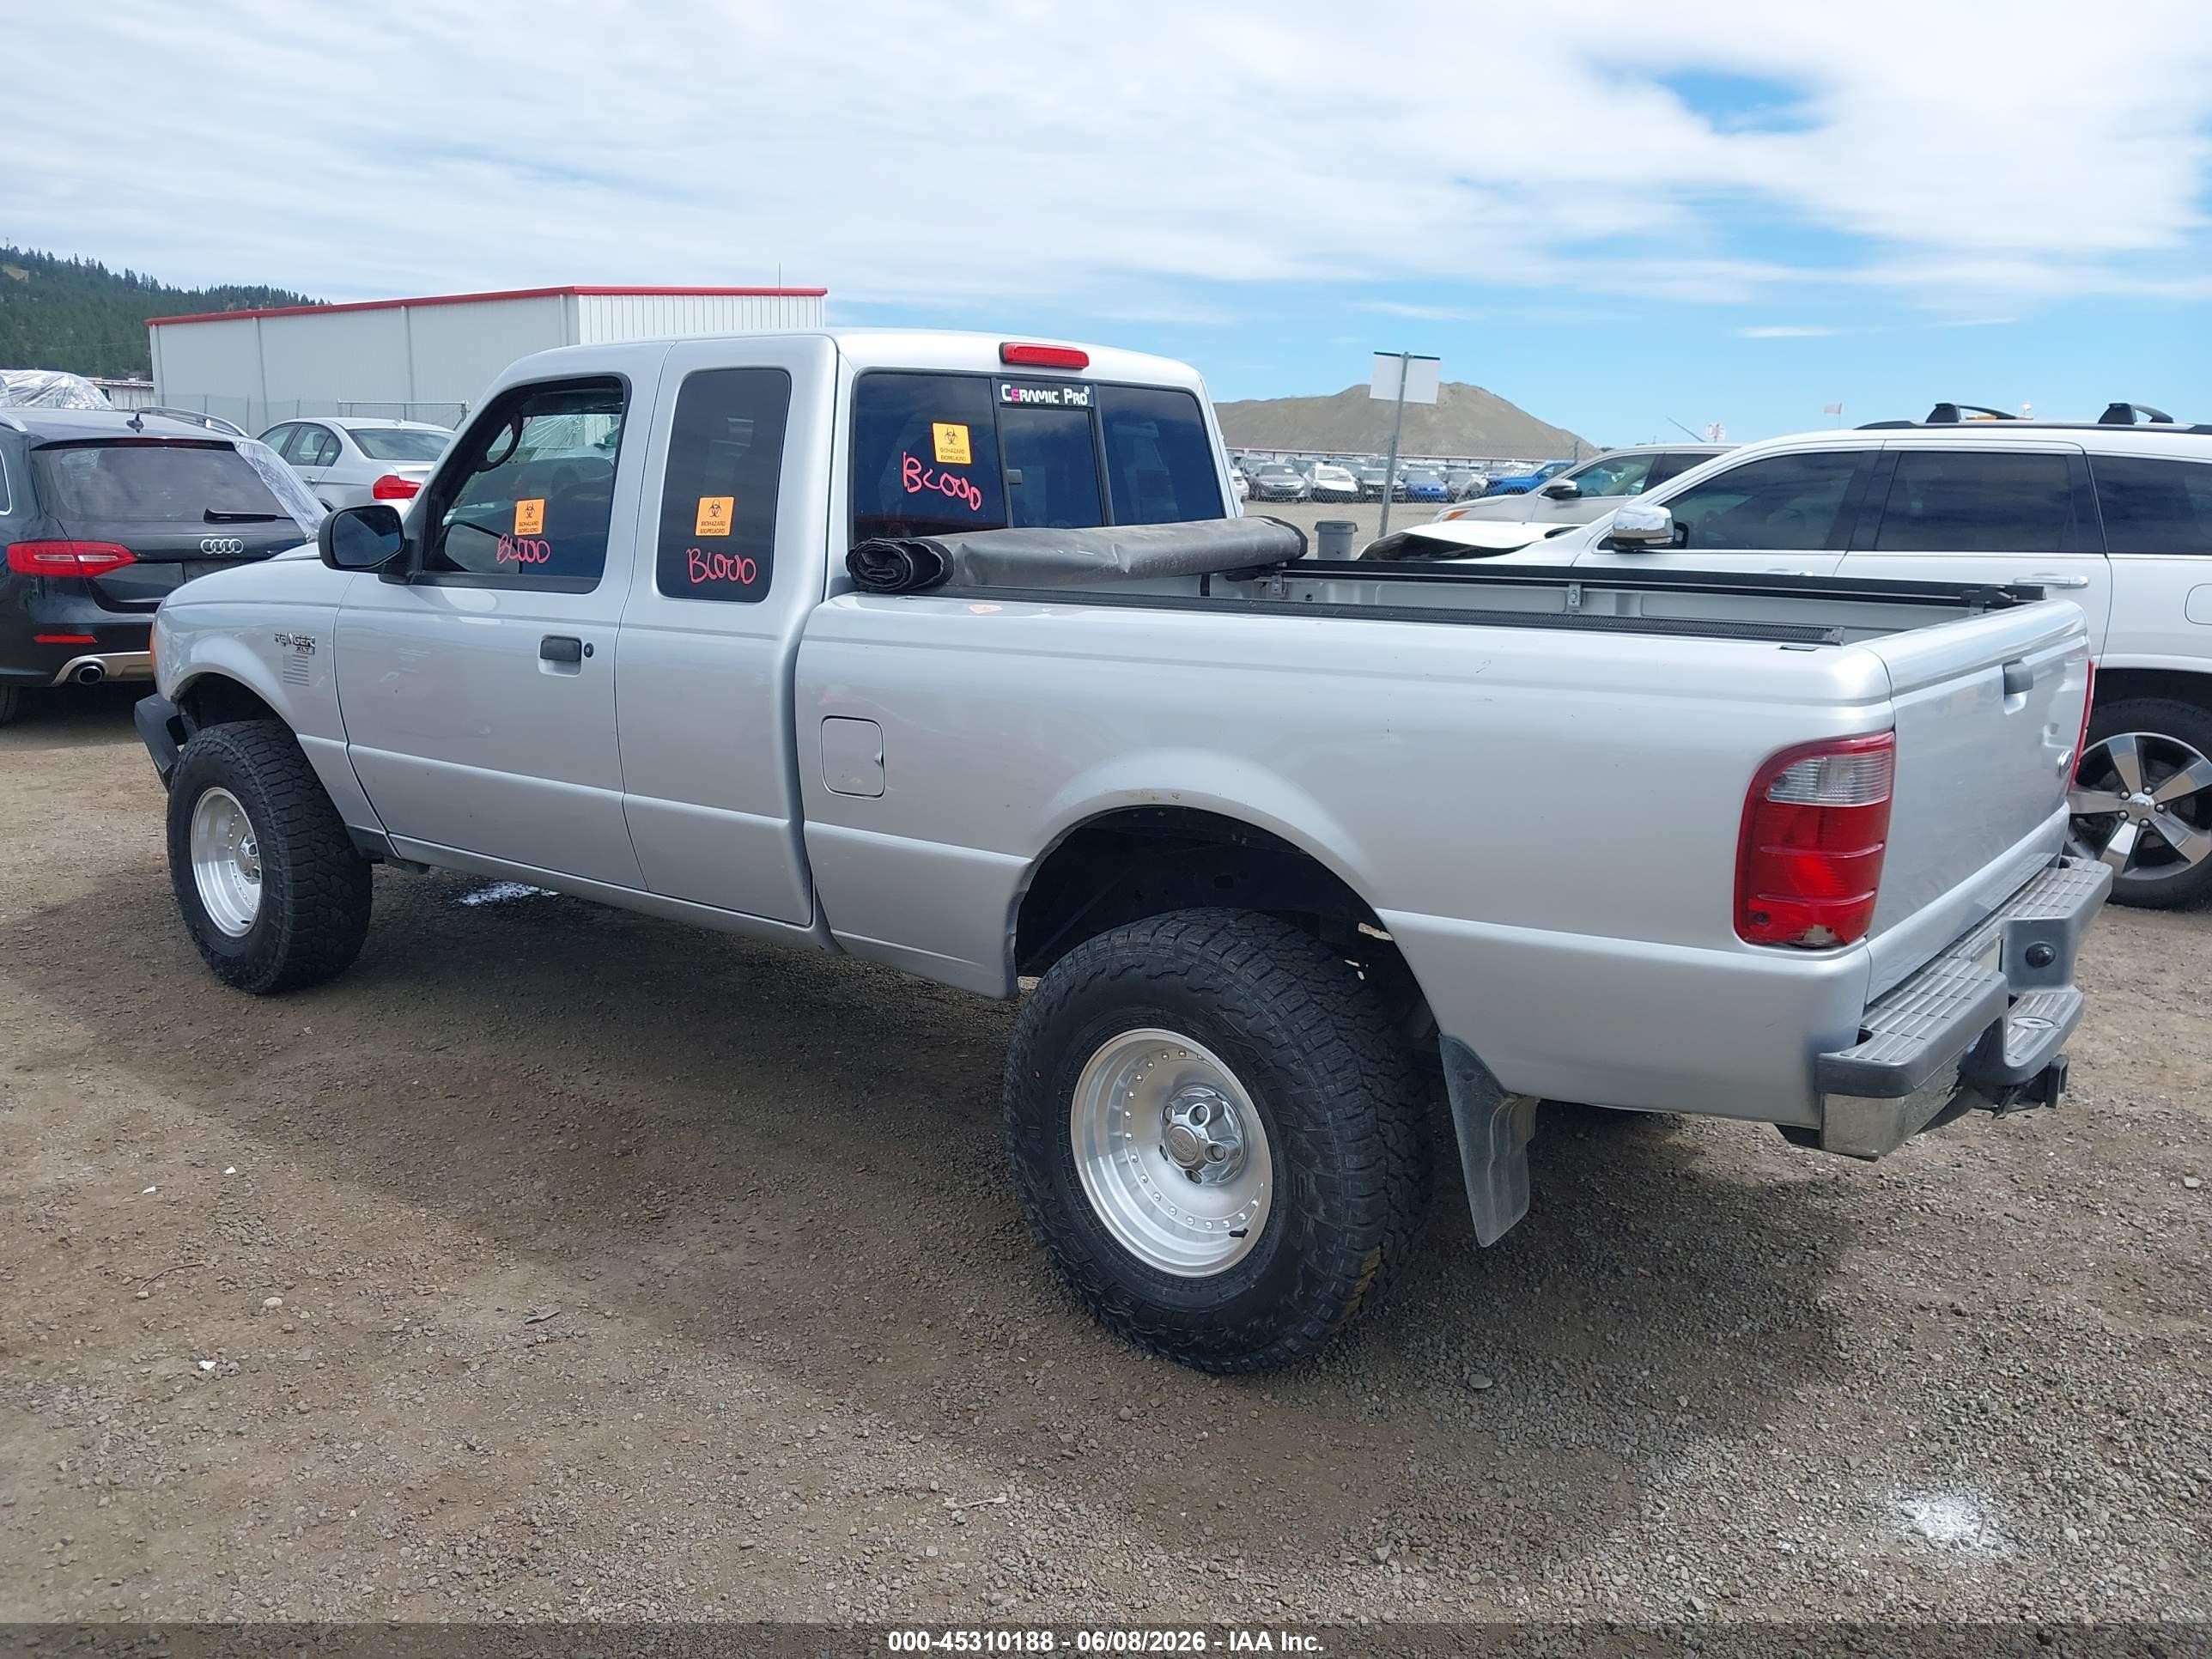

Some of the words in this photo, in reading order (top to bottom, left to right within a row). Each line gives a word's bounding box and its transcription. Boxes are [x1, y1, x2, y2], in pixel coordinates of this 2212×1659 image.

[1001, 384, 1060, 404] CERAMIC
[903, 451, 981, 511] BLOOD
[496, 533, 550, 564] BLOOD
[685, 548, 757, 585] BLOOD
